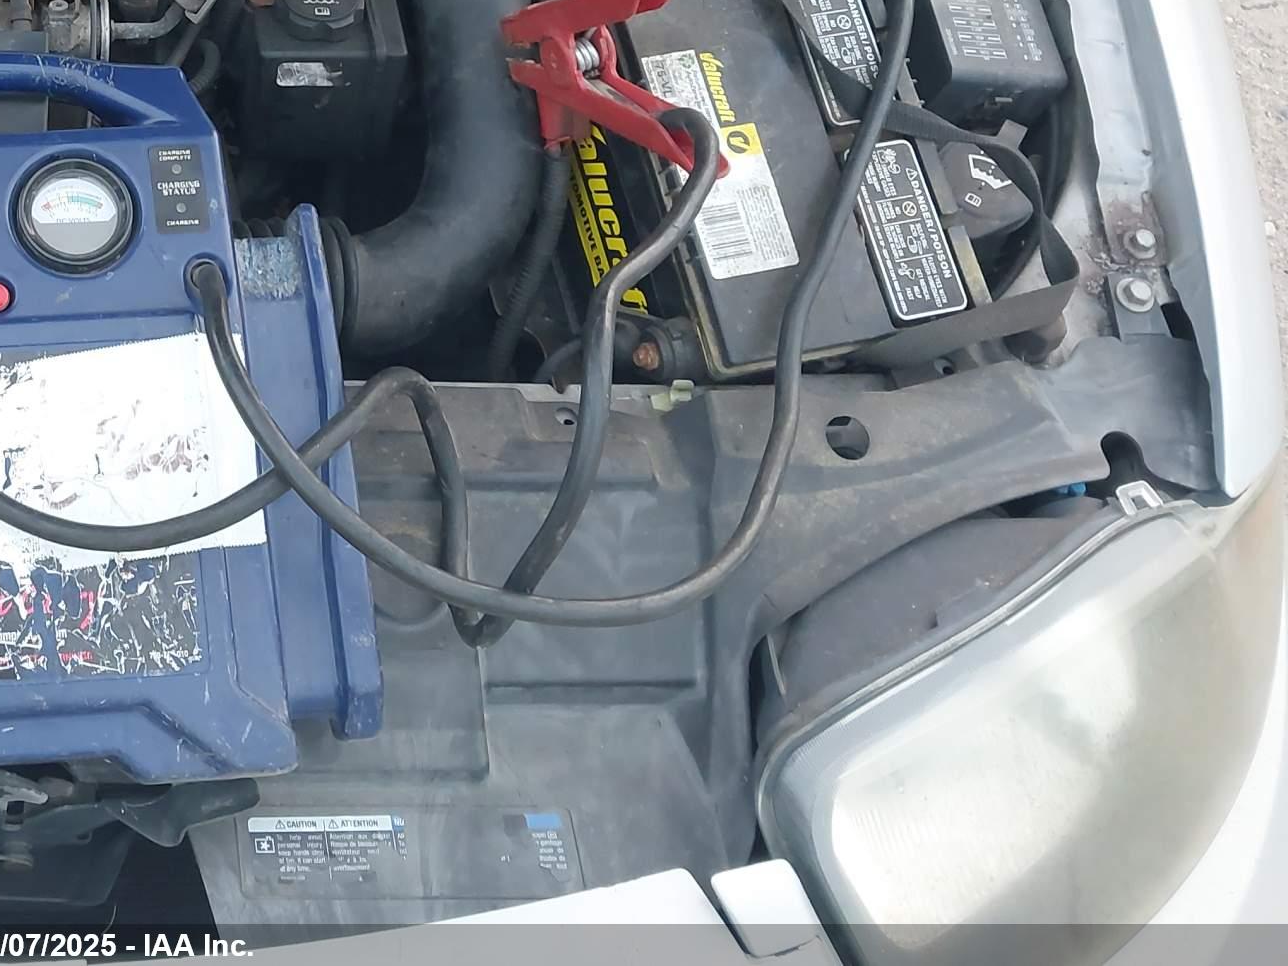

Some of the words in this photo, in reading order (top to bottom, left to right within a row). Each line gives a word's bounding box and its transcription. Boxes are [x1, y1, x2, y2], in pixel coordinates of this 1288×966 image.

[653, 62, 675, 98] 75-VL
[699, 52, 737, 123] Valucraft
[157, 180, 200, 189] CHARGING
[163, 188, 196, 196] STATUS
[909, 179, 953, 278] DANGER/POISON
[286, 820, 317, 828] CAUTION
[341, 819, 379, 828] ATTENTION
